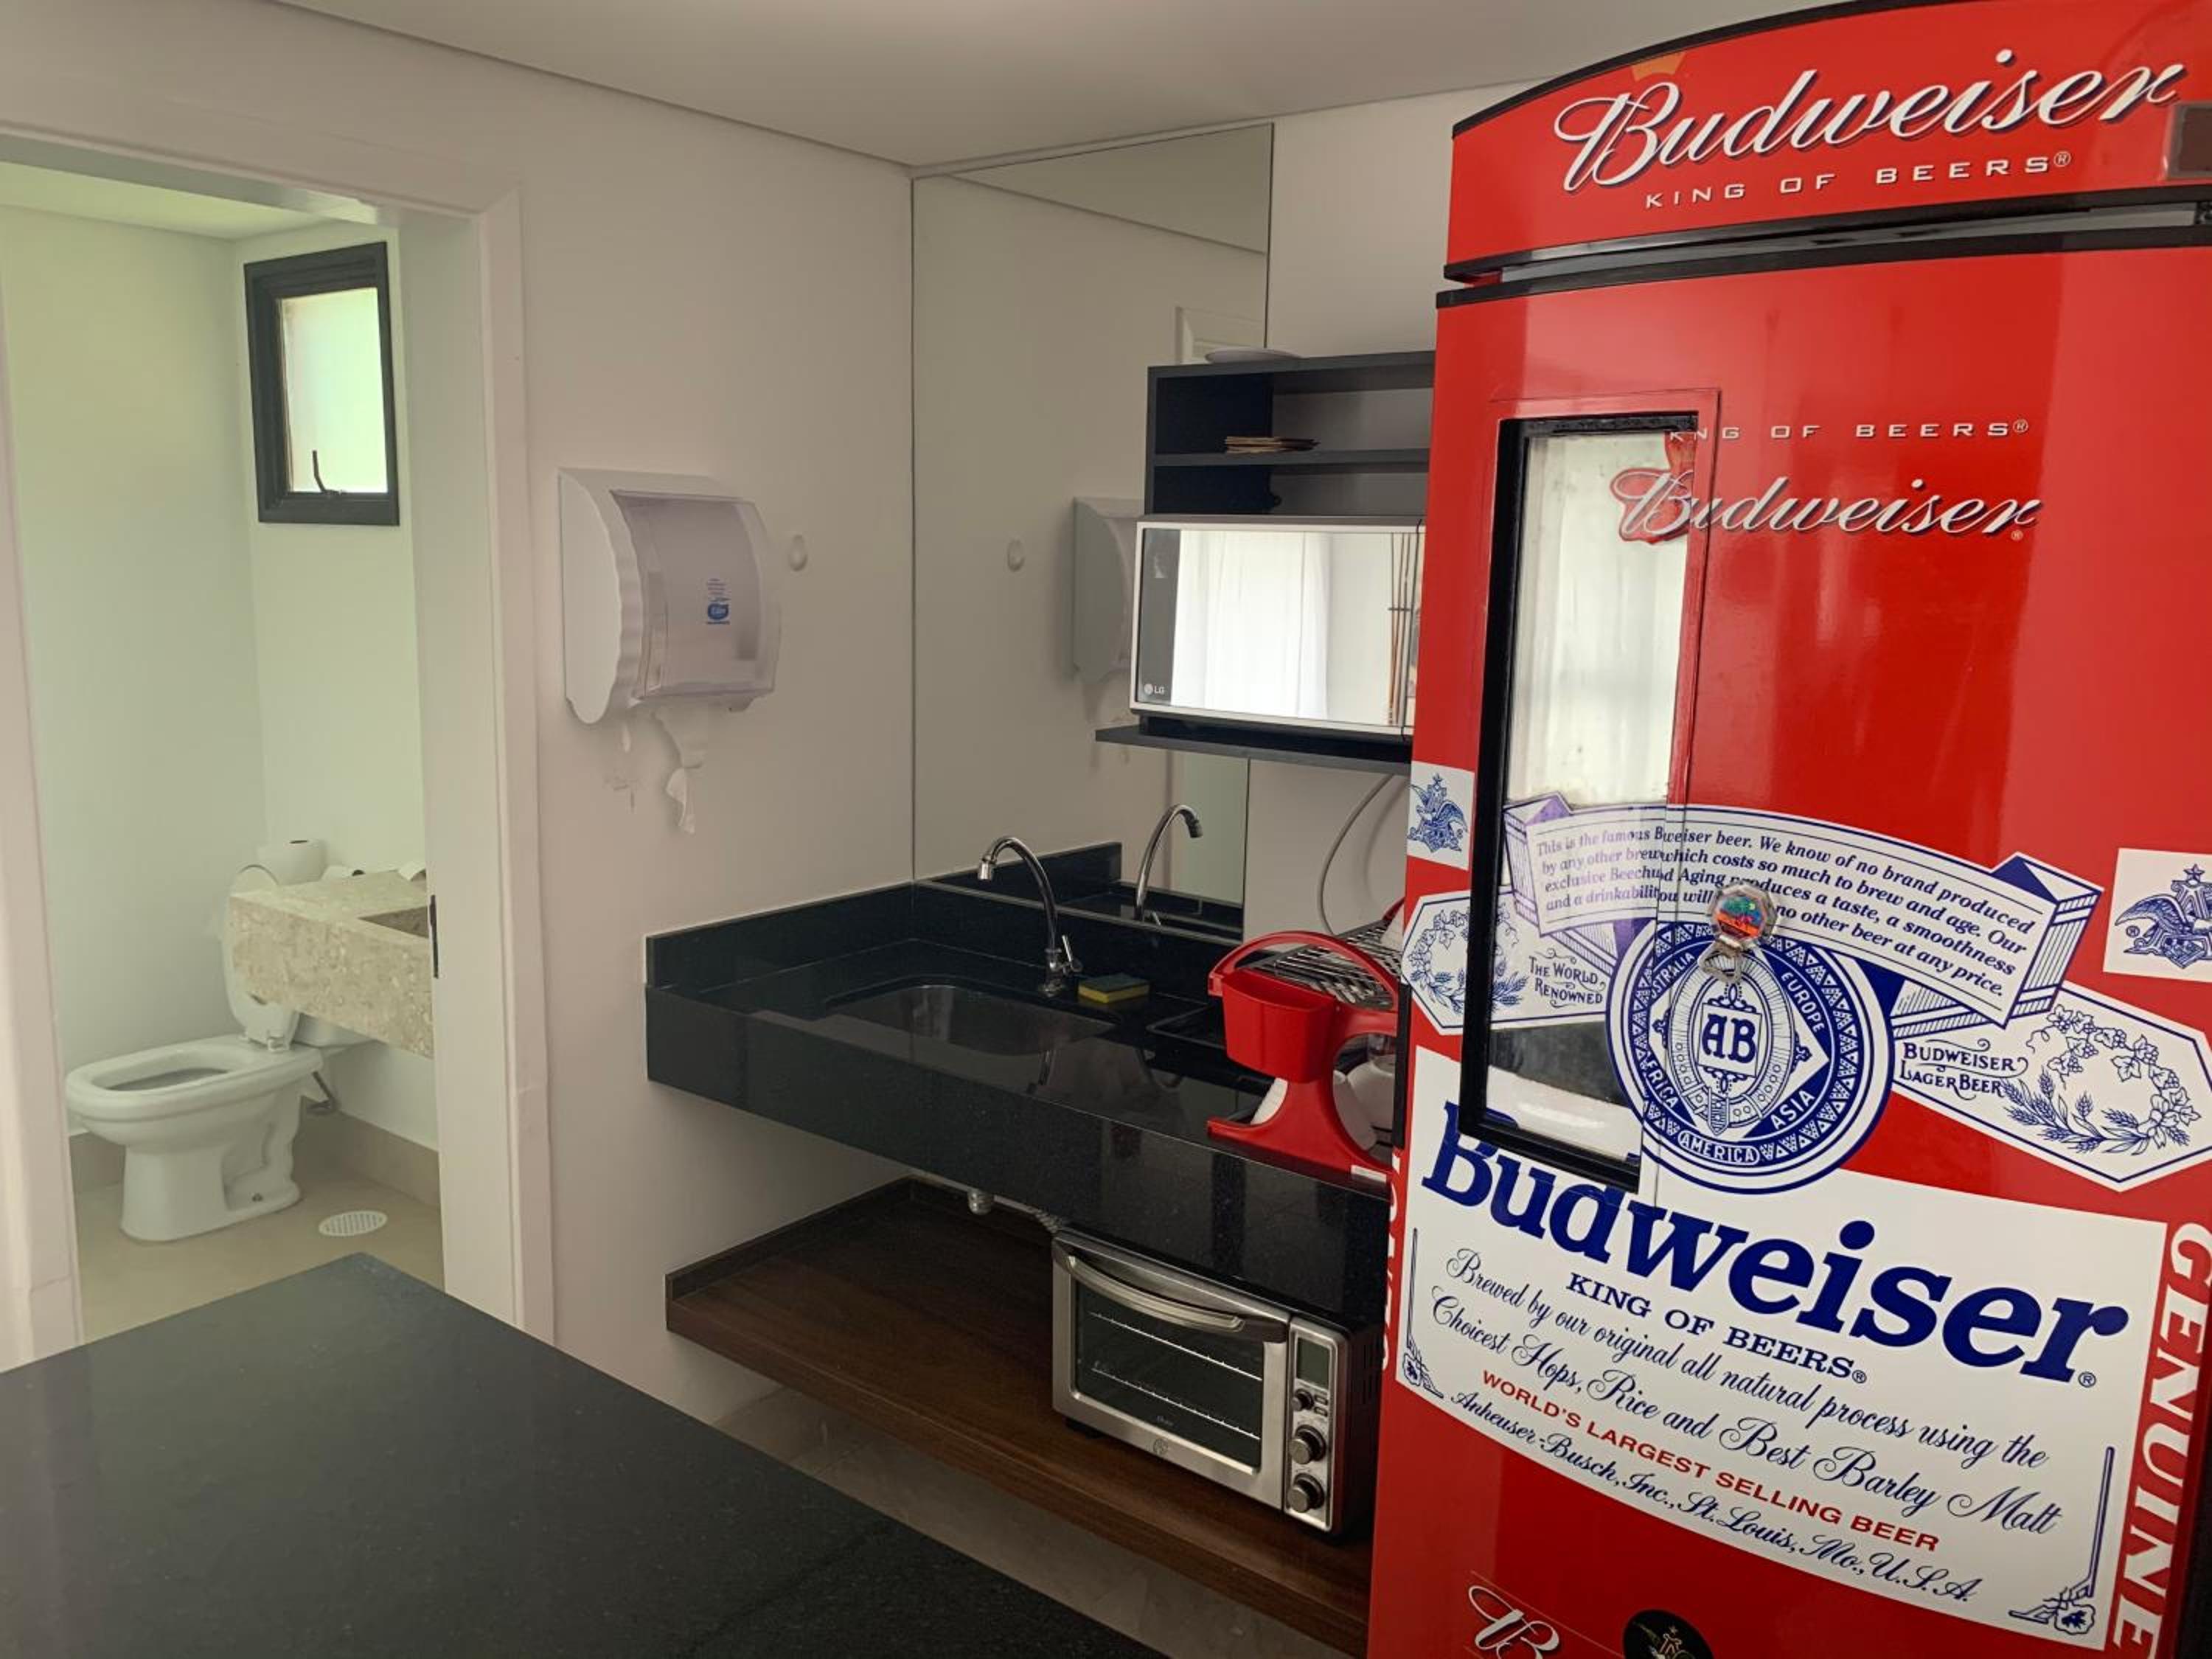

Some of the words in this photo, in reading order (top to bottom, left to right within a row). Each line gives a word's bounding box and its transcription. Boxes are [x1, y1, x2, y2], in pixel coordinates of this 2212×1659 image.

[1554, 49, 2184, 192] Budweiser
[1645, 183, 1746, 210] KING
[1779, 173, 1835, 195] OF
[1670, 425, 1741, 442] KNG
[1770, 424, 1822, 440] OF
[1537, 841, 1562, 856] This
[1565, 838, 1576, 849] is
[1580, 833, 1599, 847] the
[1601, 830, 1651, 844] famous
[1716, 830, 1753, 848] beer.
[1759, 835, 1782, 853] We
[1784, 841, 1832, 862] know
[1835, 854, 1856, 871] of
[1855, 860, 1879, 876] no
[1882, 866, 1939, 895] brand
[1935, 888, 2036, 935] produced
[1543, 860, 1557, 876] by
[1559, 858, 1583, 872] any
[1587, 849, 1622, 866] other
[1712, 853, 1755, 870] costs
[1757, 860, 1778, 872] so
[1781, 863, 1831, 885] much
[1834, 874, 1854, 891] to
[1856, 880, 1903, 906] brew
[1906, 899, 1947, 922] and
[1946, 914, 1982, 938] age.
[1987, 929, 2028, 956] Our
[1545, 872, 1607, 892] exclusive
[1678, 867, 1726, 891] Aging
[1815, 892, 1828, 905] a
[1832, 894, 1881, 922] taste,
[1885, 913, 1900, 928] a
[1902, 920, 2017, 977] smoothness
[1546, 893, 1571, 911] and
[1573, 893, 1583, 903] a
[1683, 889, 1714, 905] will
[1775, 905, 1797, 919] no
[1800, 910, 1852, 933] other
[1851, 922, 1893, 947] beer
[1893, 939, 1919, 958] at
[1918, 950, 1955, 973] any
[1950, 966, 2004, 997] price.
[1534, 977, 1604, 1004] RENOWNED
[1780, 971, 1826, 1034] EUROPE
[1646, 1050, 1680, 1108] FRICA
[1902, 1041, 2021, 1073] BUDWEISER
[1958, 1074, 2006, 1099] BEER
[1770, 1089, 1817, 1131] ASIA
[1680, 1131, 1758, 1164] AMERICA
[1566, 1271, 1652, 1319] KING
[1663, 1309, 1716, 1338] OF
[1445, 1247, 1526, 1309] Brewed
[1527, 1294, 1554, 1328] by
[1554, 1310, 1591, 1336] our
[1593, 1325, 1686, 1368] original
[1681, 1349, 1722, 1382] all
[1720, 1371, 1821, 1413] natural
[1804, 1394, 1915, 1439] process
[1918, 1423, 1998, 1470] using
[2000, 1433, 2051, 1469] the
[1430, 1284, 1513, 1354] Choicest
[1511, 1332, 1583, 1393] Hops,
[1586, 1368, 1662, 1420] Rice
[1663, 1412, 1720, 1441] and
[1718, 1416, 1812, 1470] Best
[1812, 1445, 1942, 1520] Barley
[1946, 1485, 2064, 1536] Malt
[2112, 1221, 2212, 1659] GENUINE
[1481, 1368, 1583, 1429] WORLD'S
[1585, 1420, 1712, 1479] LARGEST
[1714, 1471, 1843, 1526] SELLING
[1848, 1515, 1941, 1553] BEER
